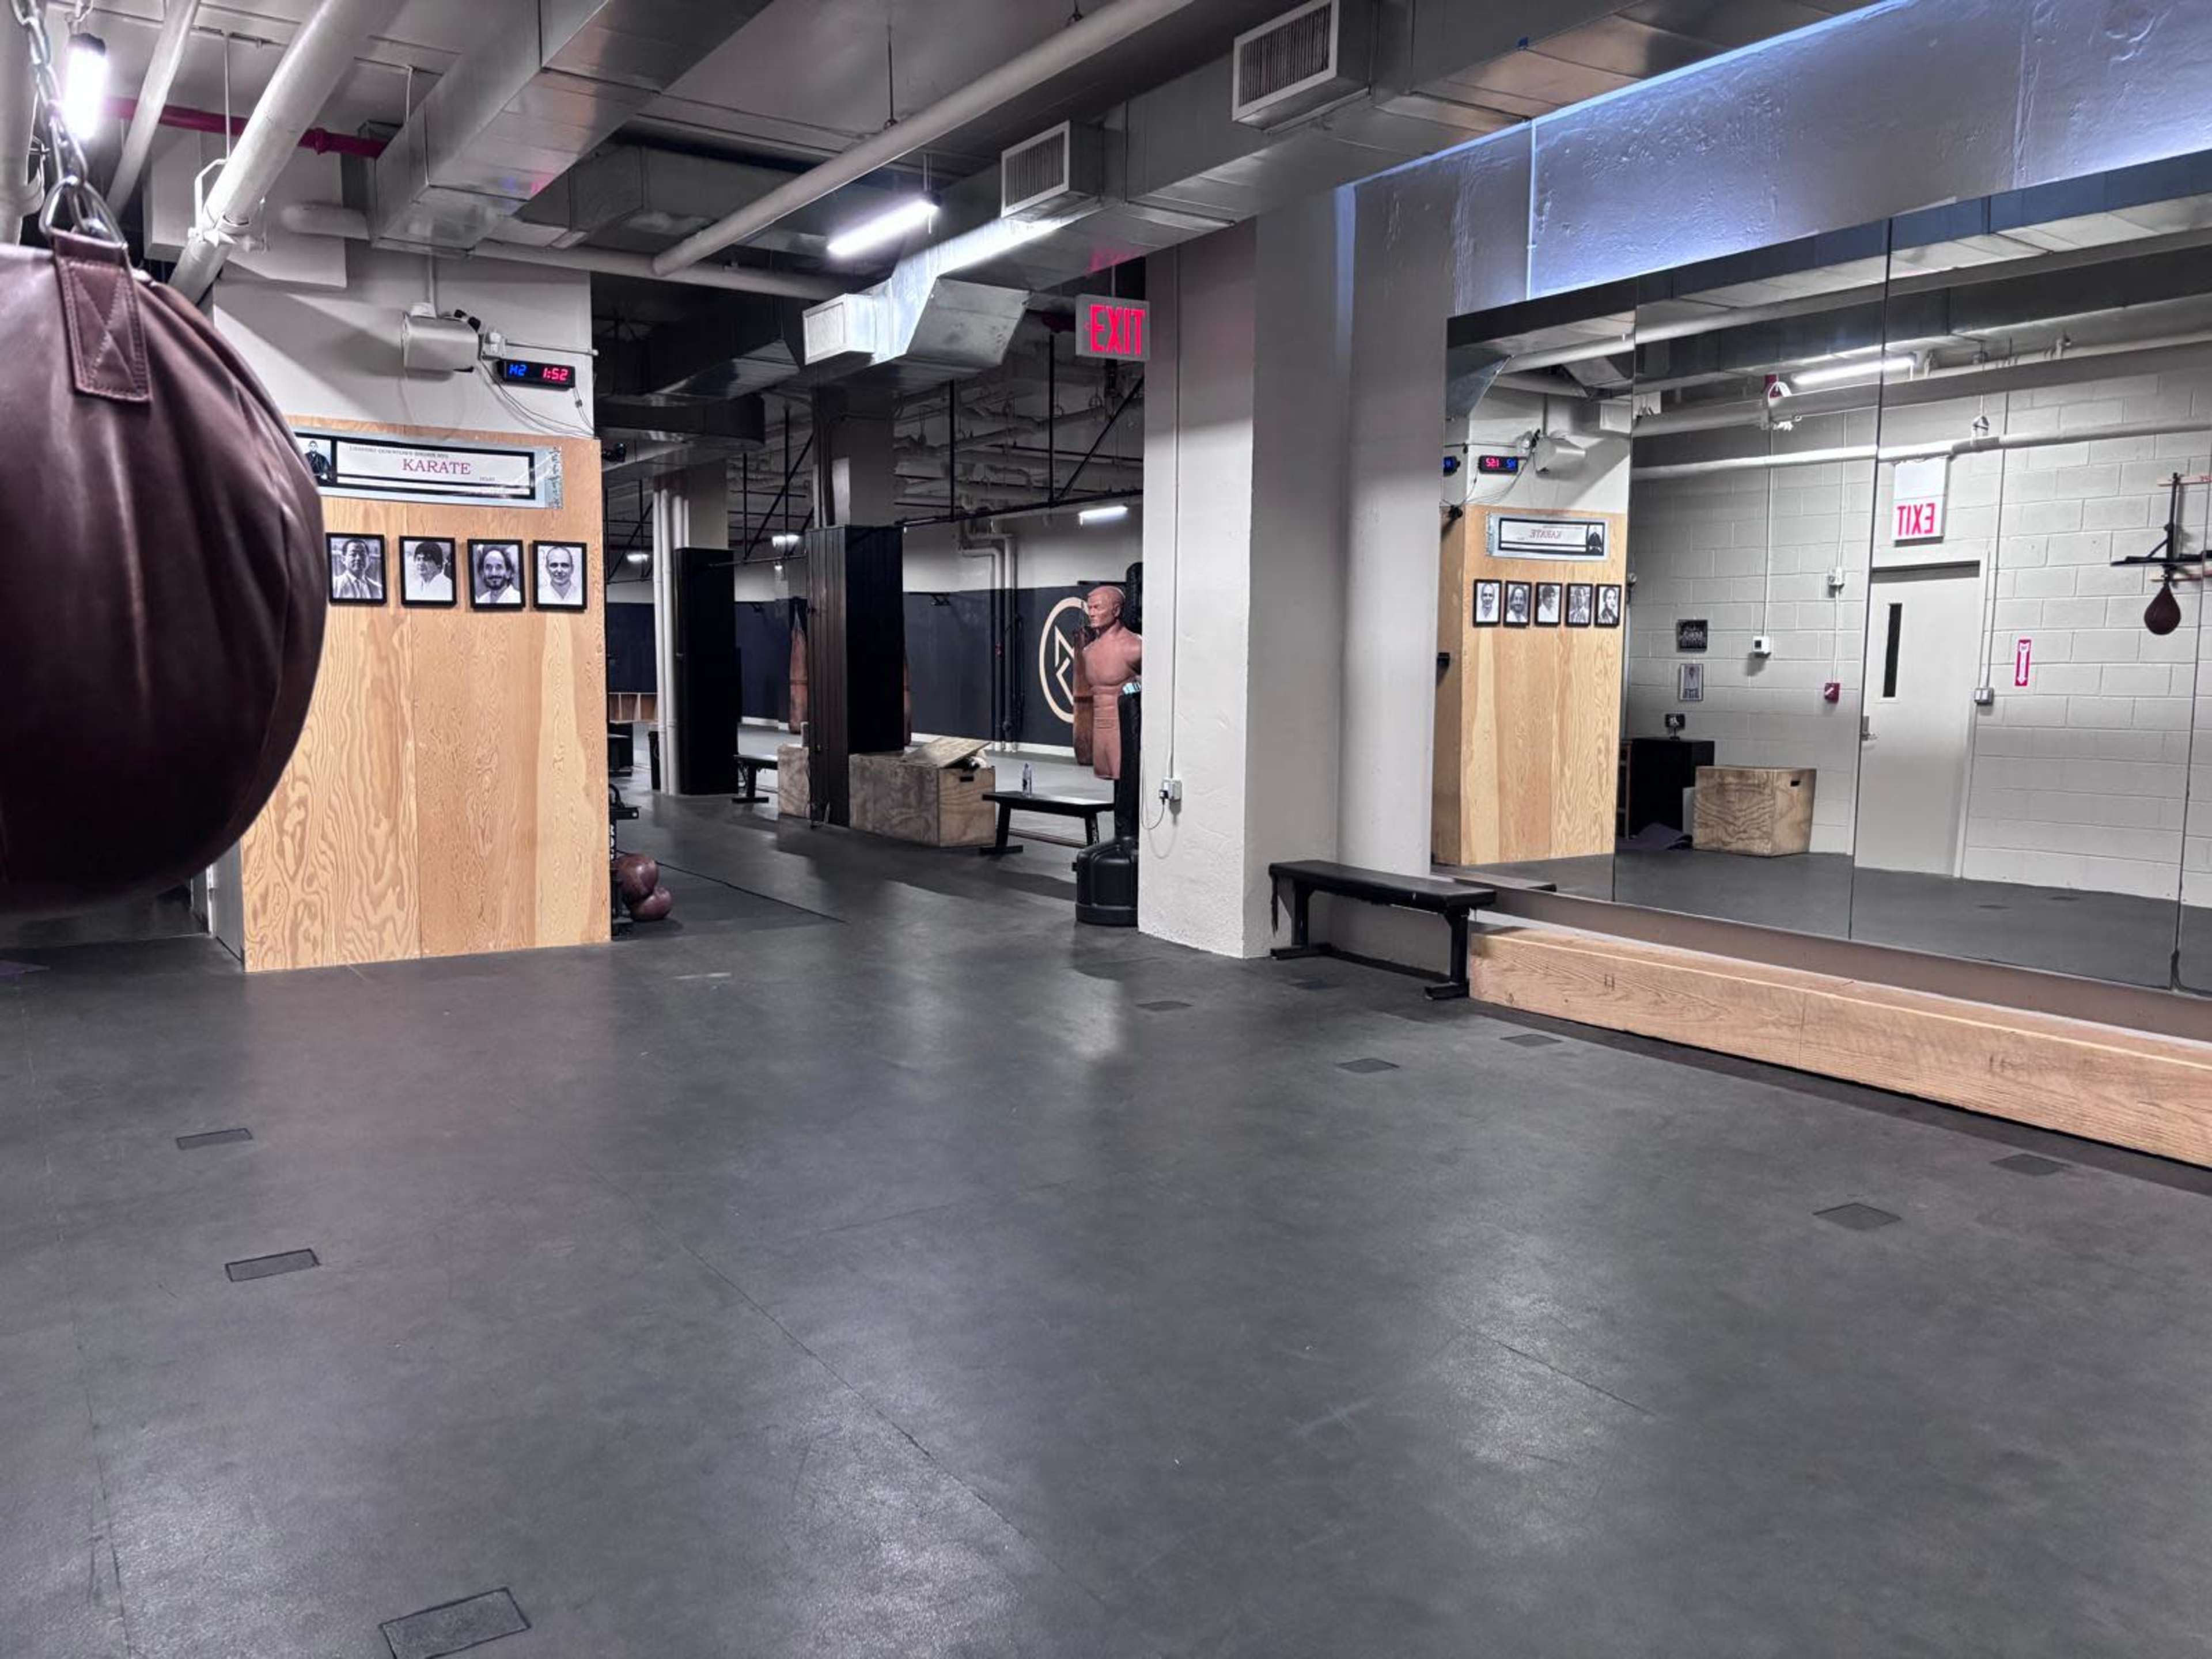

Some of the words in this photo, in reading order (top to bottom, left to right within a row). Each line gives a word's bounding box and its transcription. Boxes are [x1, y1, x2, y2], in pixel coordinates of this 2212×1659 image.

[1089, 304, 1146, 355] EXIT
[542, 367, 569, 381] 1:52
[402, 458, 471, 475] KARATE
